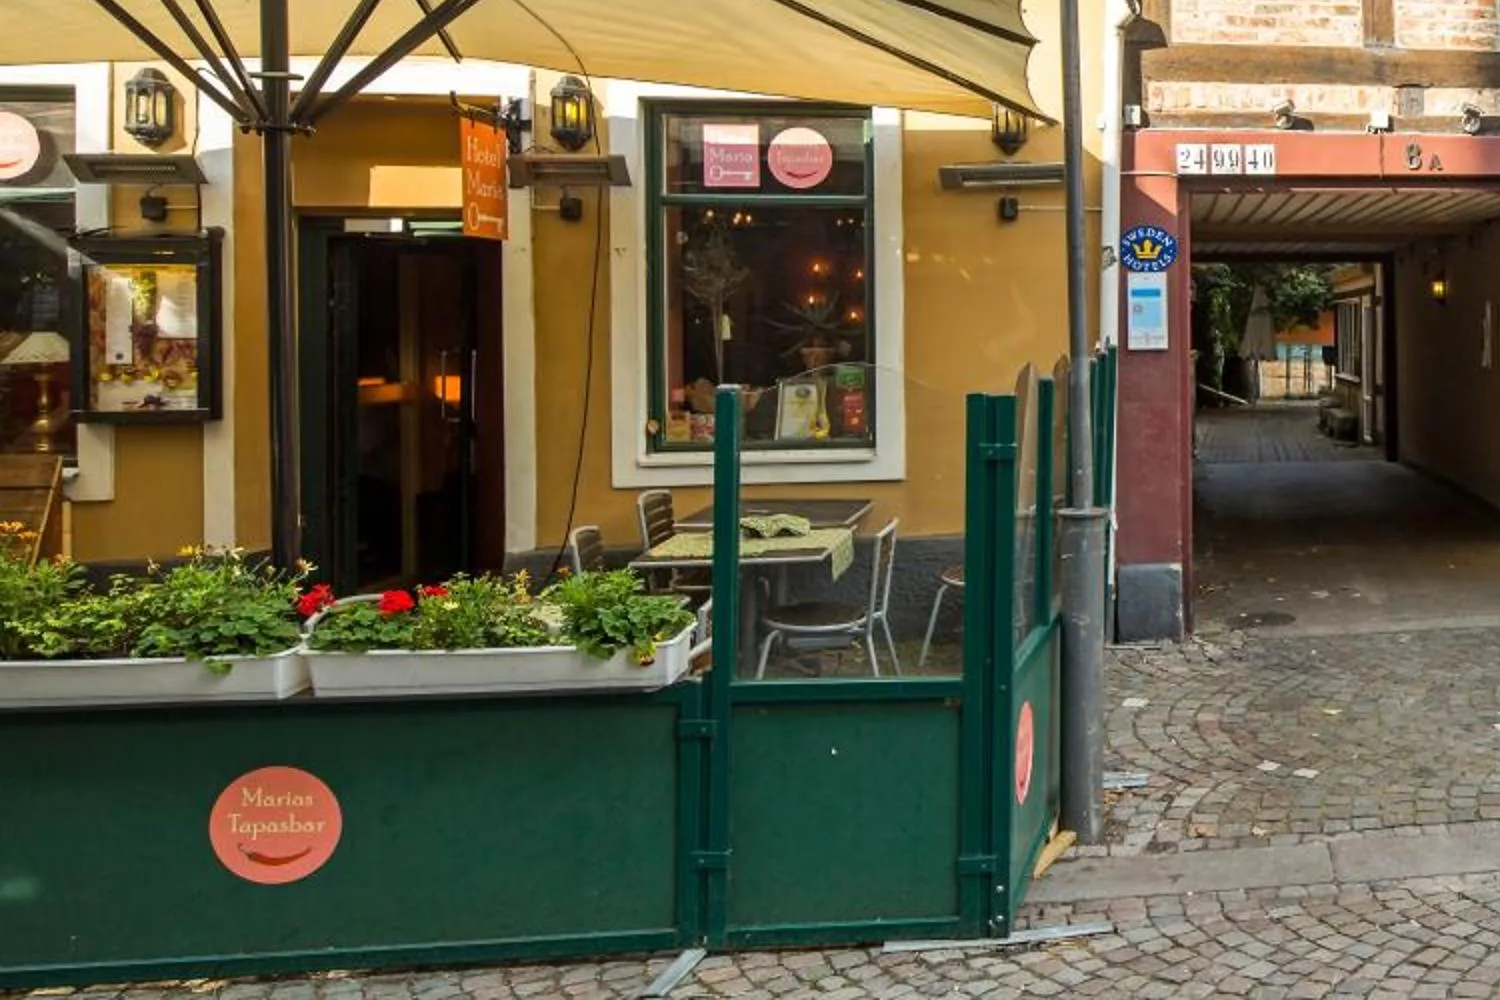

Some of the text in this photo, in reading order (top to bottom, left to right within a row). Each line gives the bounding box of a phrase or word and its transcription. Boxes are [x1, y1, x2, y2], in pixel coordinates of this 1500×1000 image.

[467, 135, 500, 168] Hotel
[708, 147, 753, 163] Maria
[1121, 227, 1173, 247] SWEDEN
[1123, 253, 1172, 271] HOTELS
[241, 786, 313, 807] Marias
[227, 812, 326, 841] Tapasbar
